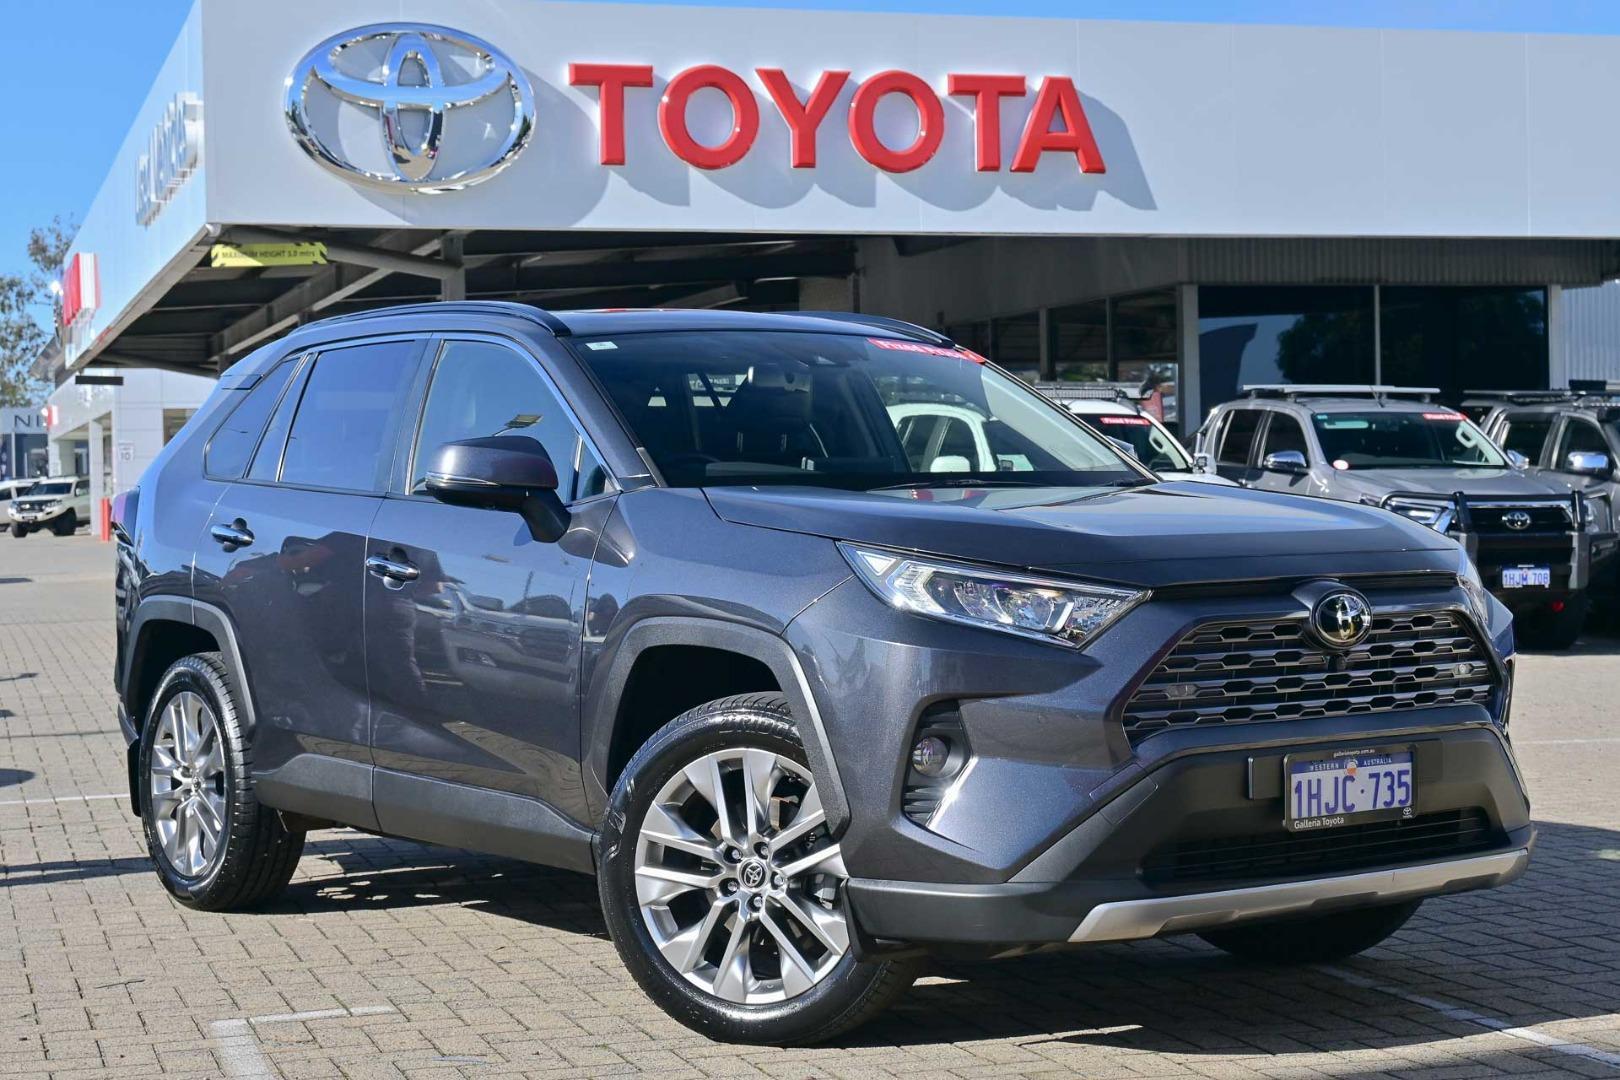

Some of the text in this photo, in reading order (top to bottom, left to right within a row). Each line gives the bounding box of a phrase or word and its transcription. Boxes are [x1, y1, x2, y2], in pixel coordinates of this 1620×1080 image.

[568, 63, 1106, 174] TOYOTA
[259, 250, 286, 258] HEIGHT
[1309, 757, 1392, 771] WESTERN AUSTRALIA
[1294, 816, 1345, 830] Galleria Toyota
